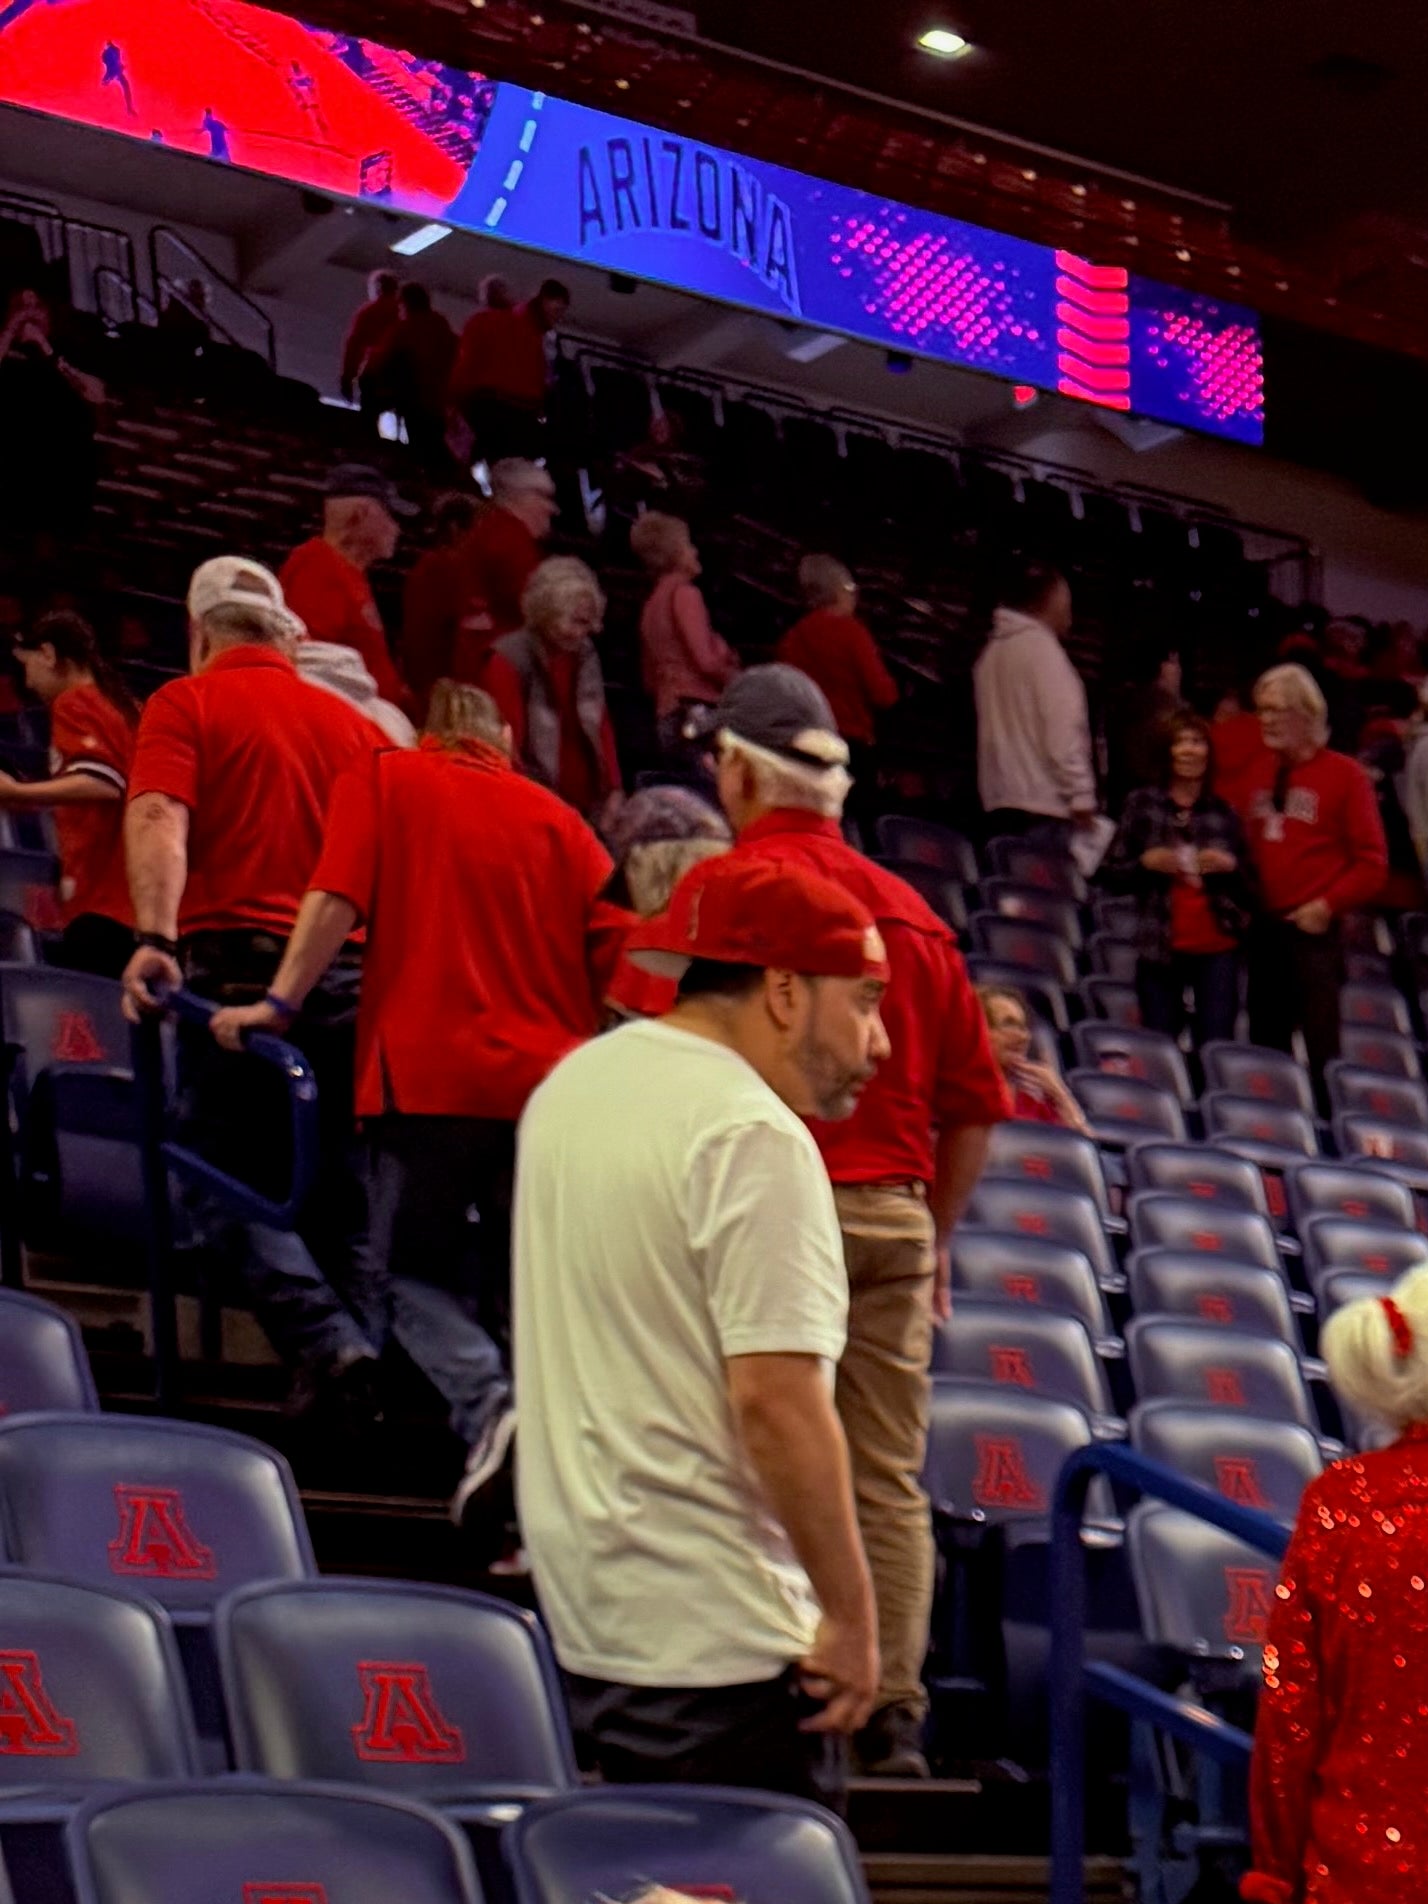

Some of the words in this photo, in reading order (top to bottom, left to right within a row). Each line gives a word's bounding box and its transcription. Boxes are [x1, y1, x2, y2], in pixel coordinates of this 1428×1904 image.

[577, 136, 802, 317] ARIZONA
[108, 1482, 216, 1580] A
[350, 1659, 466, 1764] A
